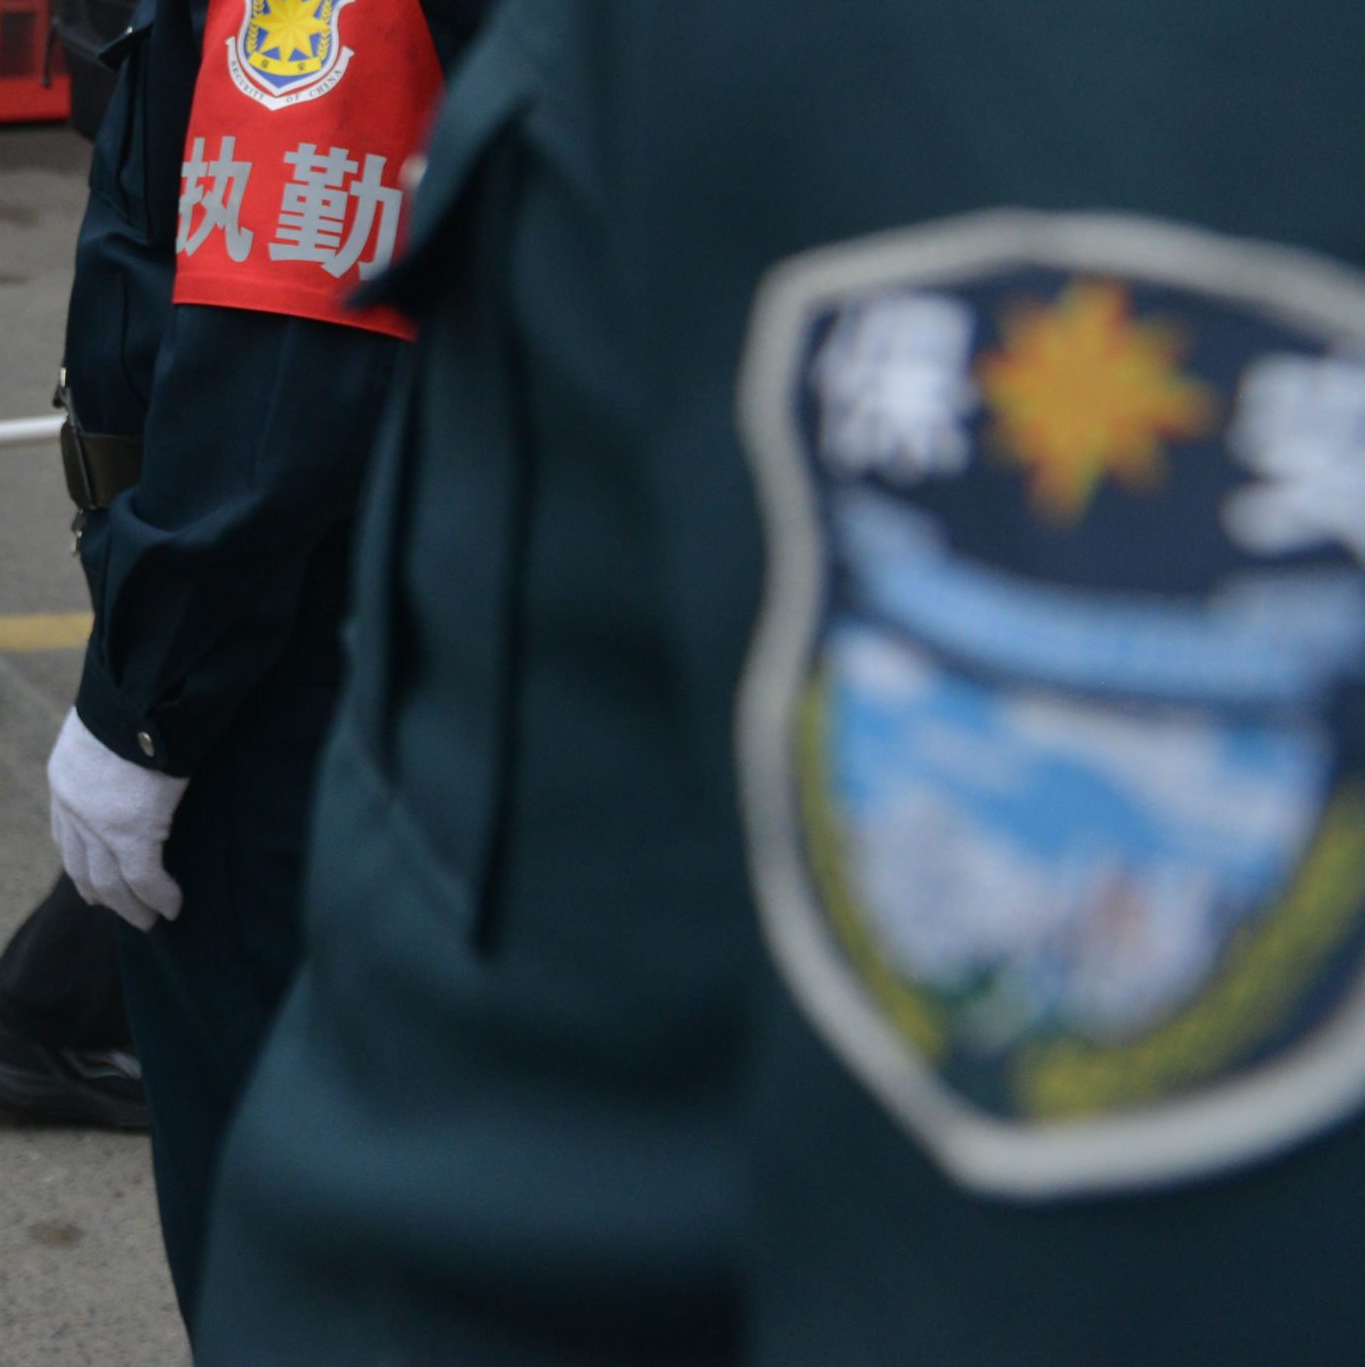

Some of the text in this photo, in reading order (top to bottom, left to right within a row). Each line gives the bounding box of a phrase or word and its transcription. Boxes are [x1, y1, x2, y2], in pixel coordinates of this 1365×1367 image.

[284, 94, 302, 104] OF
[308, 69, 344, 98] CHINA
[176, 136, 403, 282] 执勤
